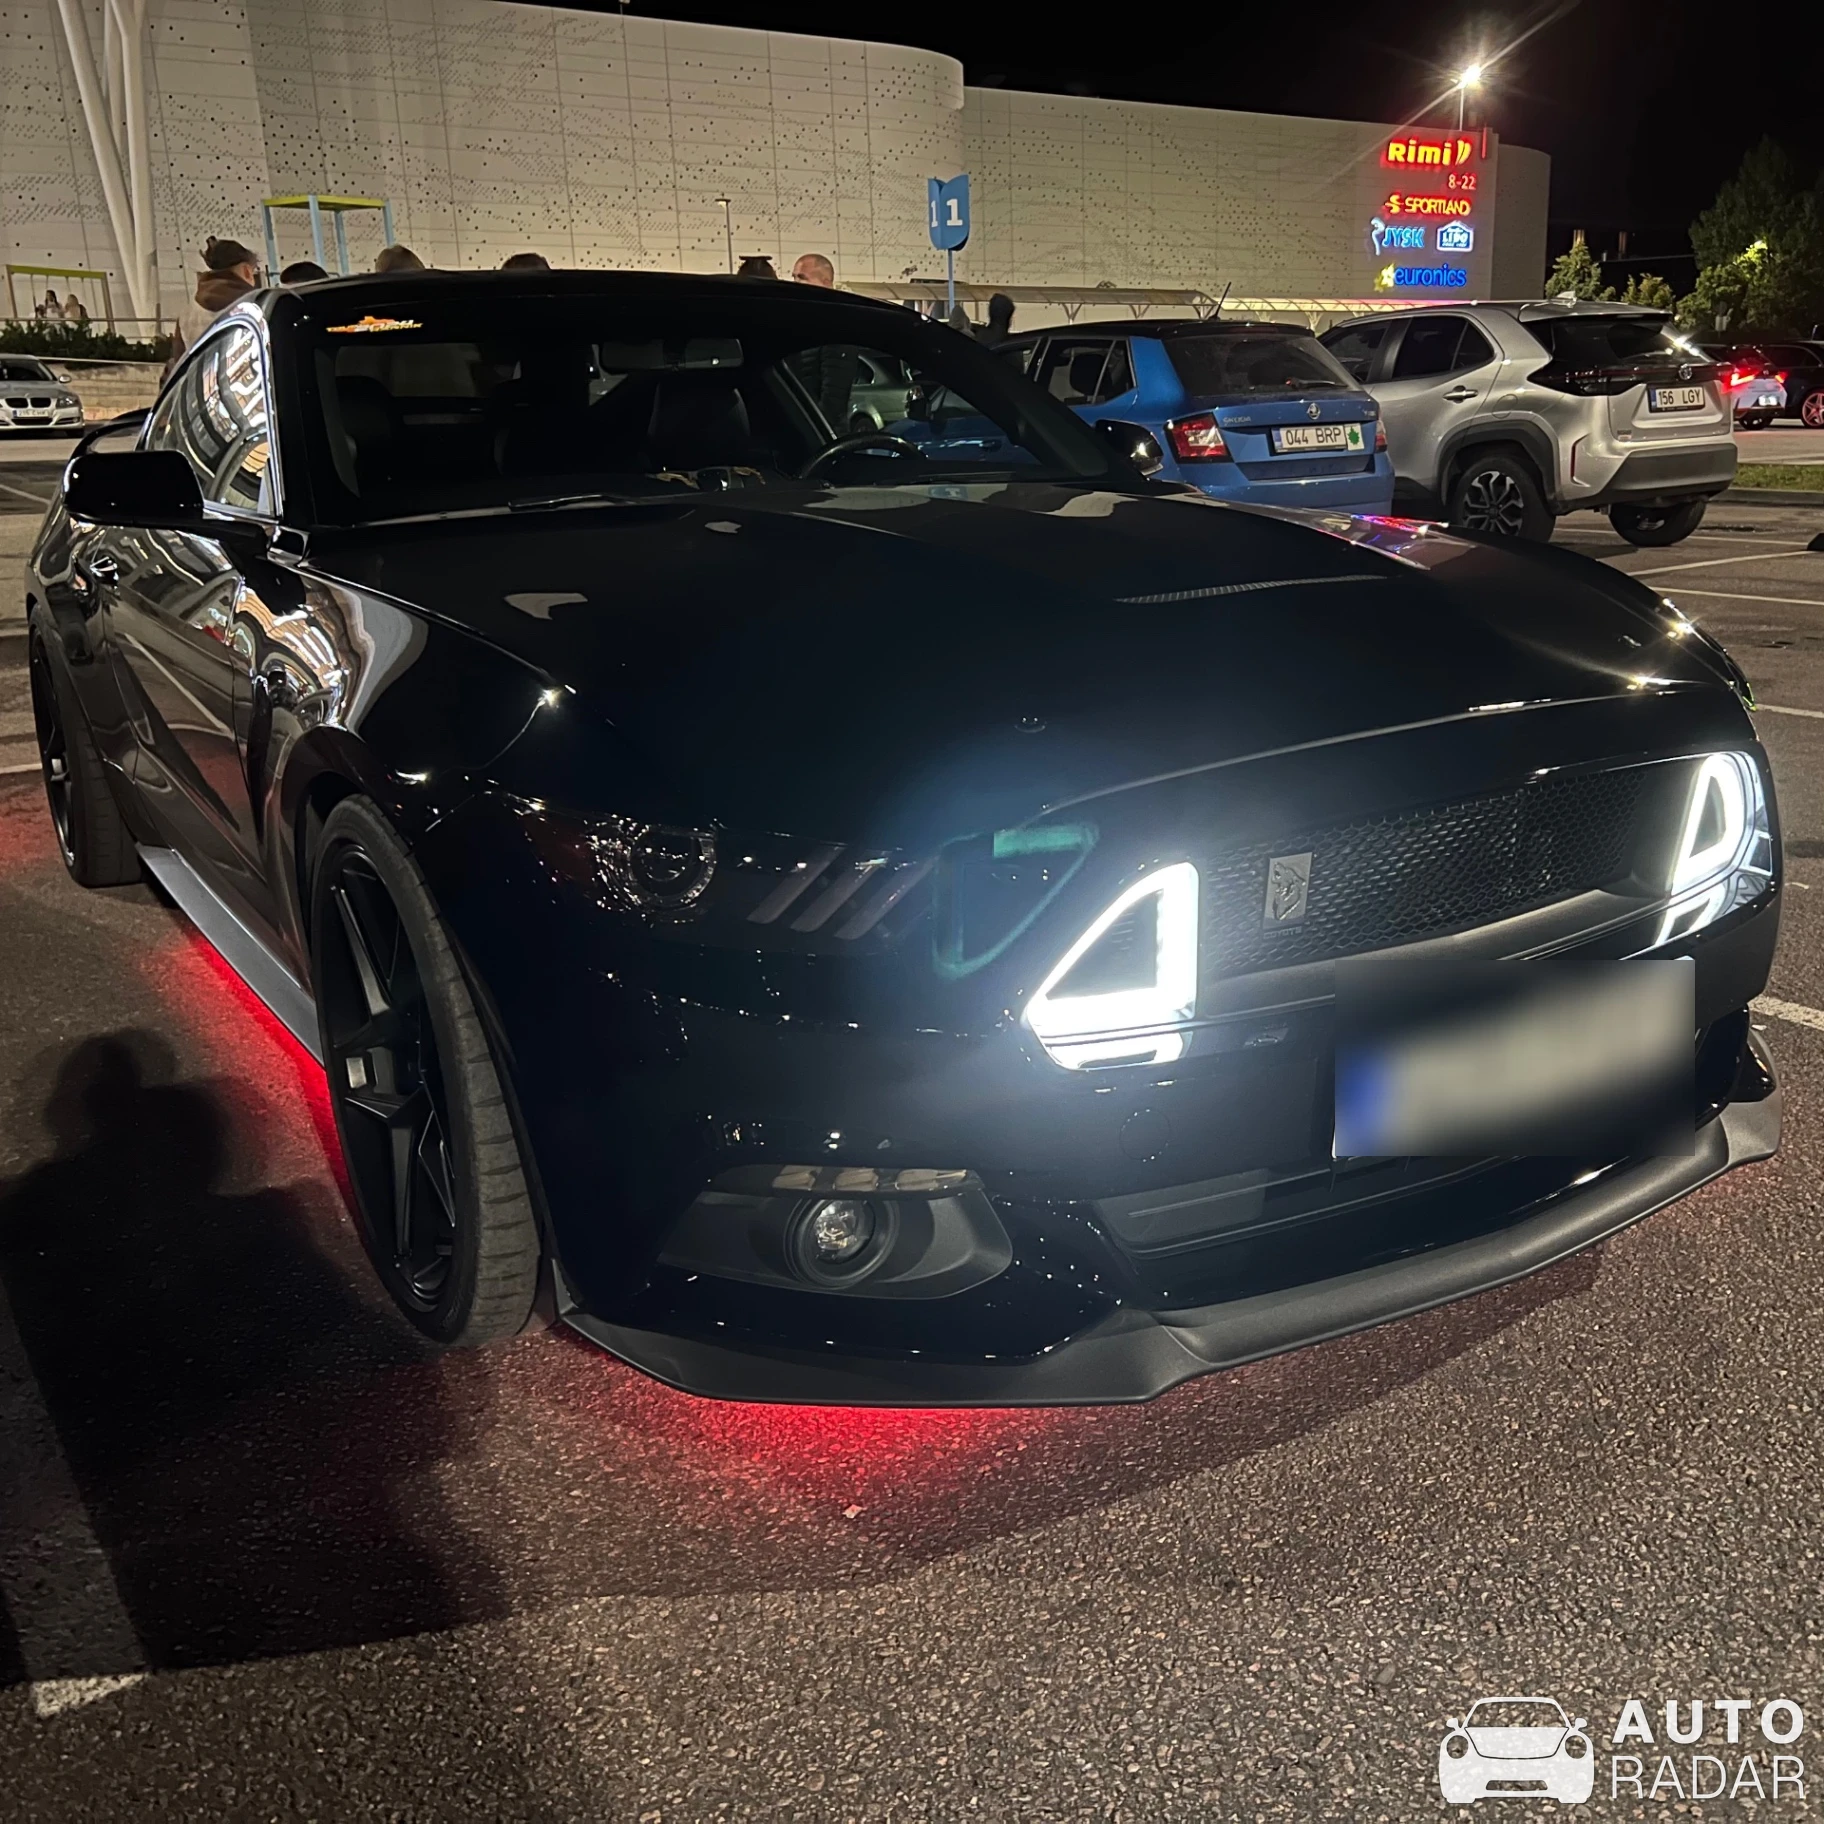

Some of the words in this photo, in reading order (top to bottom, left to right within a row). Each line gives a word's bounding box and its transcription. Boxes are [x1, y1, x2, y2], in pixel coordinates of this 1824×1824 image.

[1387, 139, 1452, 166] Rimi
[1448, 174, 1476, 190] 8-22
[946, 198, 963, 226] 1
[1405, 197, 1472, 216] SPORTLAND
[1382, 226, 1426, 248] JYSK
[1394, 264, 1467, 286] euronics
[1658, 390, 1674, 406] 156
[1682, 388, 1701, 404] LGY
[1286, 430, 1309, 445] 044
[1316, 427, 1341, 444] BRP
[1263, 926, 1303, 939] COYOTE
